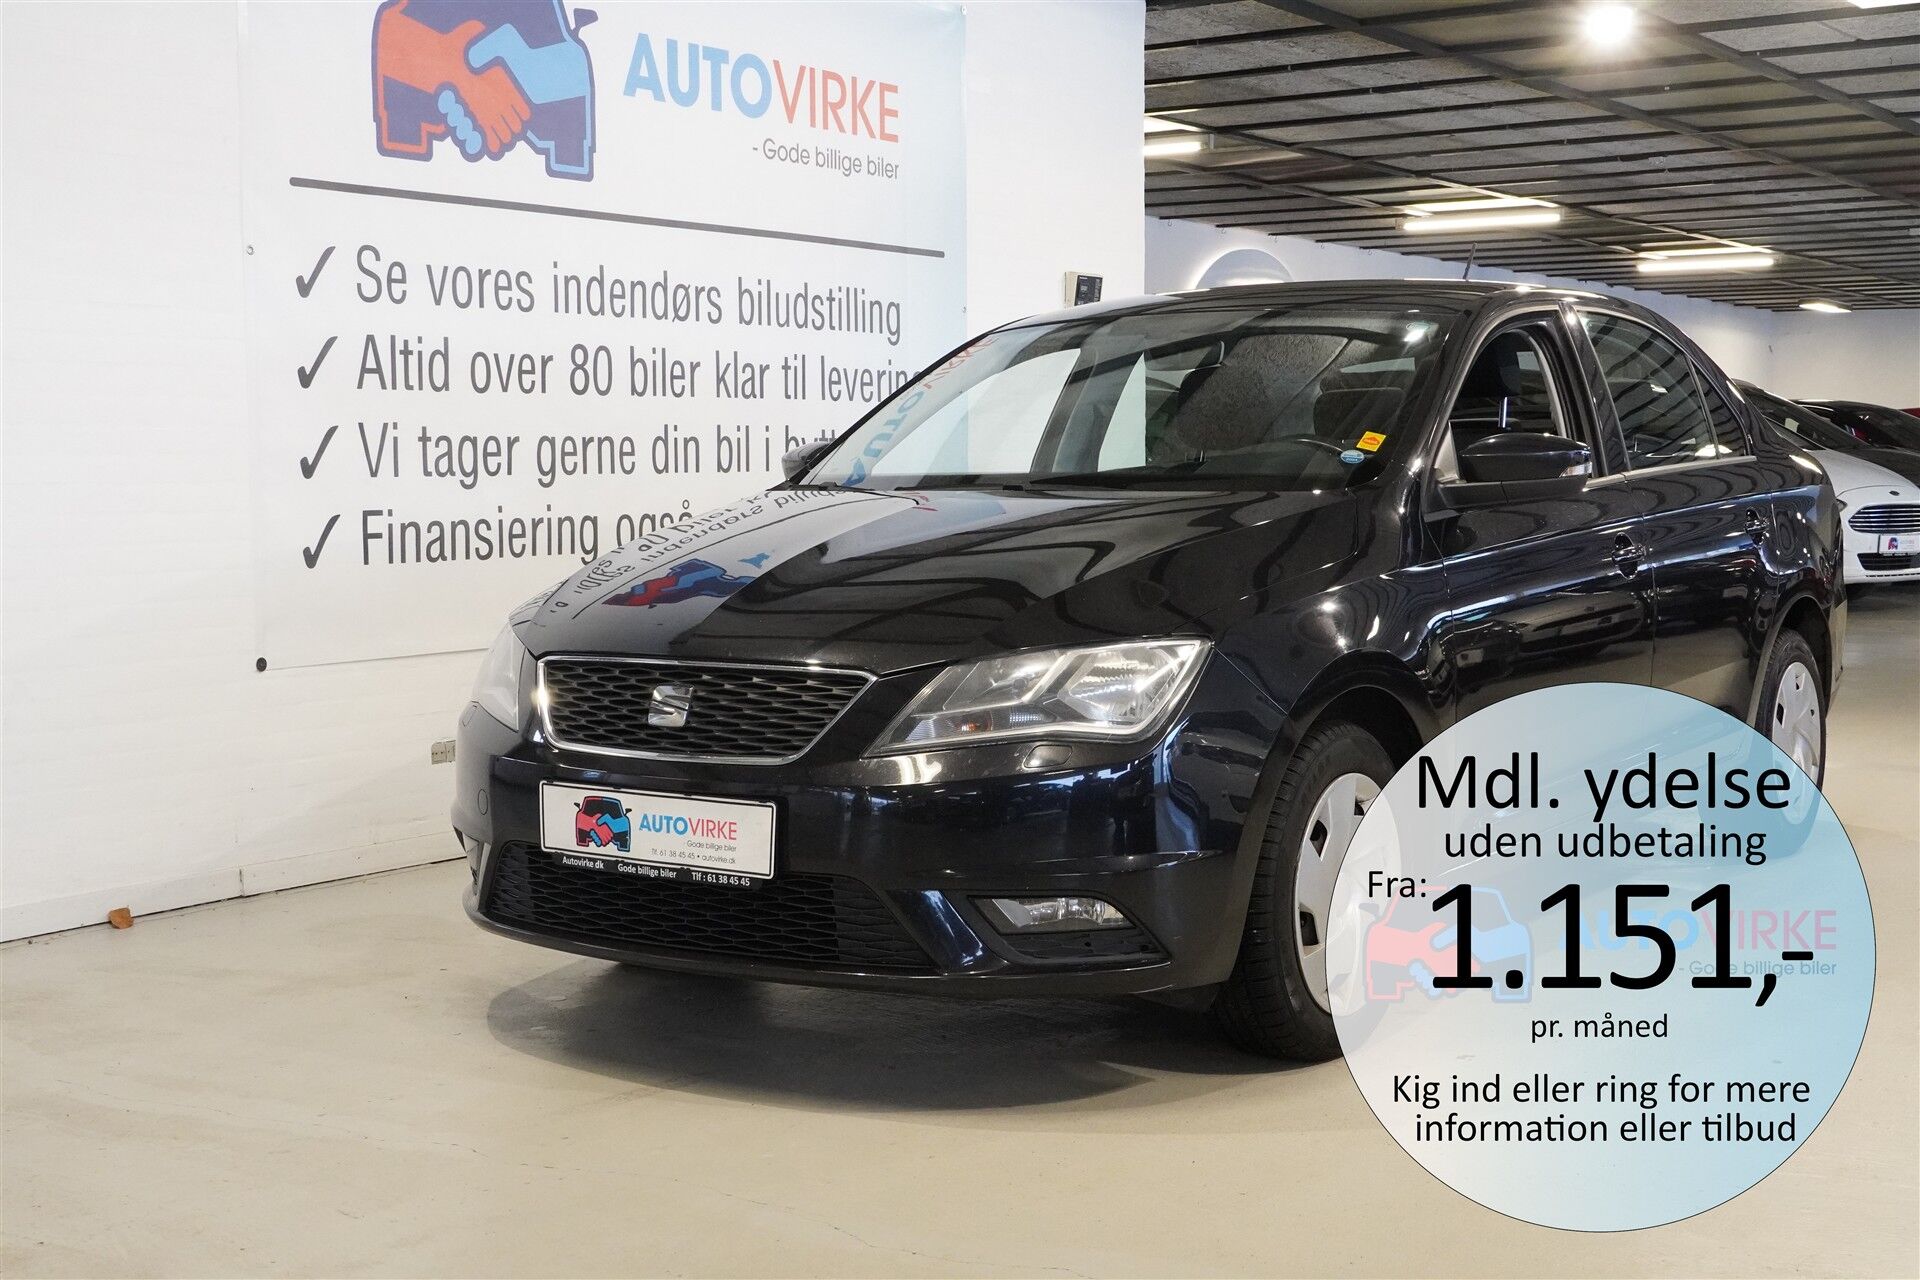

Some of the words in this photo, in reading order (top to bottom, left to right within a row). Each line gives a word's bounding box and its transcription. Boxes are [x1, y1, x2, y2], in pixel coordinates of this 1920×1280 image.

[623, 32, 899, 143] AUTOVIRKE
[763, 138, 810, 165] Gode
[815, 147, 862, 177] billige
[867, 155, 899, 179] biler
[356, 244, 407, 305] Se
[425, 264, 535, 313] vores
[553, 261, 723, 325] indendørs
[737, 276, 901, 347] biludstilling
[356, 334, 450, 393] Altid
[470, 351, 554, 395] over
[569, 343, 613, 397] 80
[629, 345, 701, 399] biler
[715, 350, 771, 400] klar
[781, 353, 807, 401] til
[821, 355, 921, 403] leverin
[357, 421, 400, 478] Vi
[417, 425, 520, 490] tager
[536, 435, 636, 489] gerne
[651, 423, 700, 475] din
[716, 424, 750, 474] bil
[764, 424, 771, 473] i
[362, 504, 598, 566] Finansiering
[639, 813, 737, 840] AUTOVIRKE
[563, 856, 594, 868] Autovirke
[687, 840, 704, 848] Gode
[706, 842, 723, 851] billige
[724, 843, 736, 852] biler
[687, 852, 696, 860] 45
[618, 864, 636, 873] Gode
[638, 867, 659, 877] billige
[660, 869, 677, 878] biler
[692, 872, 702, 881] Tlf
[707, 874, 717, 882] 61
[718, 876, 728, 884] 38
[740, 878, 750, 886] 45
